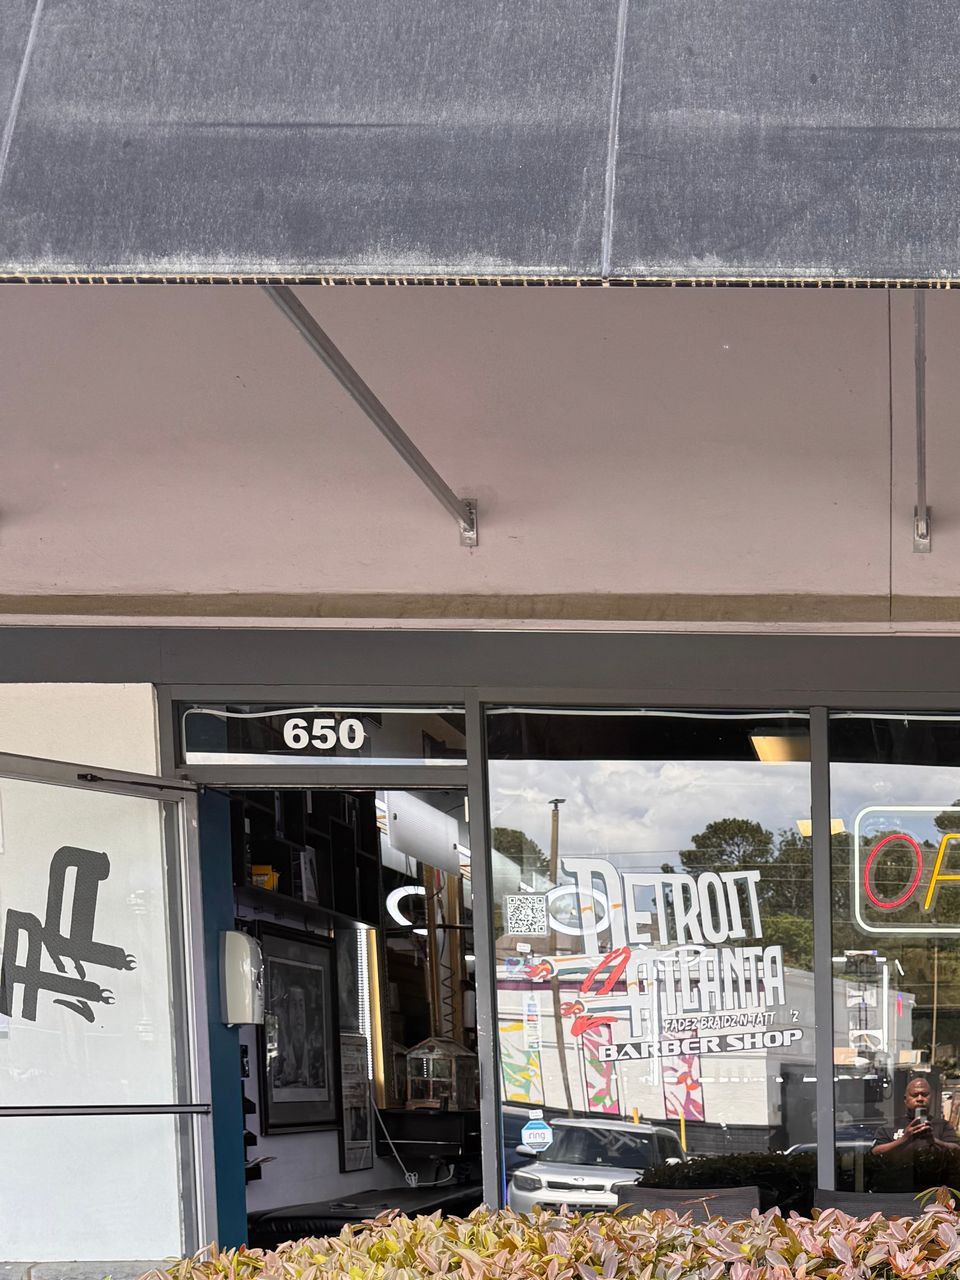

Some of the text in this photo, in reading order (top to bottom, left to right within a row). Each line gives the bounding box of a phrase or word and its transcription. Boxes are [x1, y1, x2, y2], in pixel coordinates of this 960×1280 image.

[283, 718, 365, 750] 650
[560, 857, 763, 960] DETROIT
[626, 944, 787, 1038] ATLANTA
[664, 1018, 699, 1033] FADEZ
[700, 1015, 738, 1030] BRAIDZ
[739, 1014, 748, 1026] N
[598, 1028, 804, 1063] BARBER SHOP
[528, 1132, 546, 1141] ring
